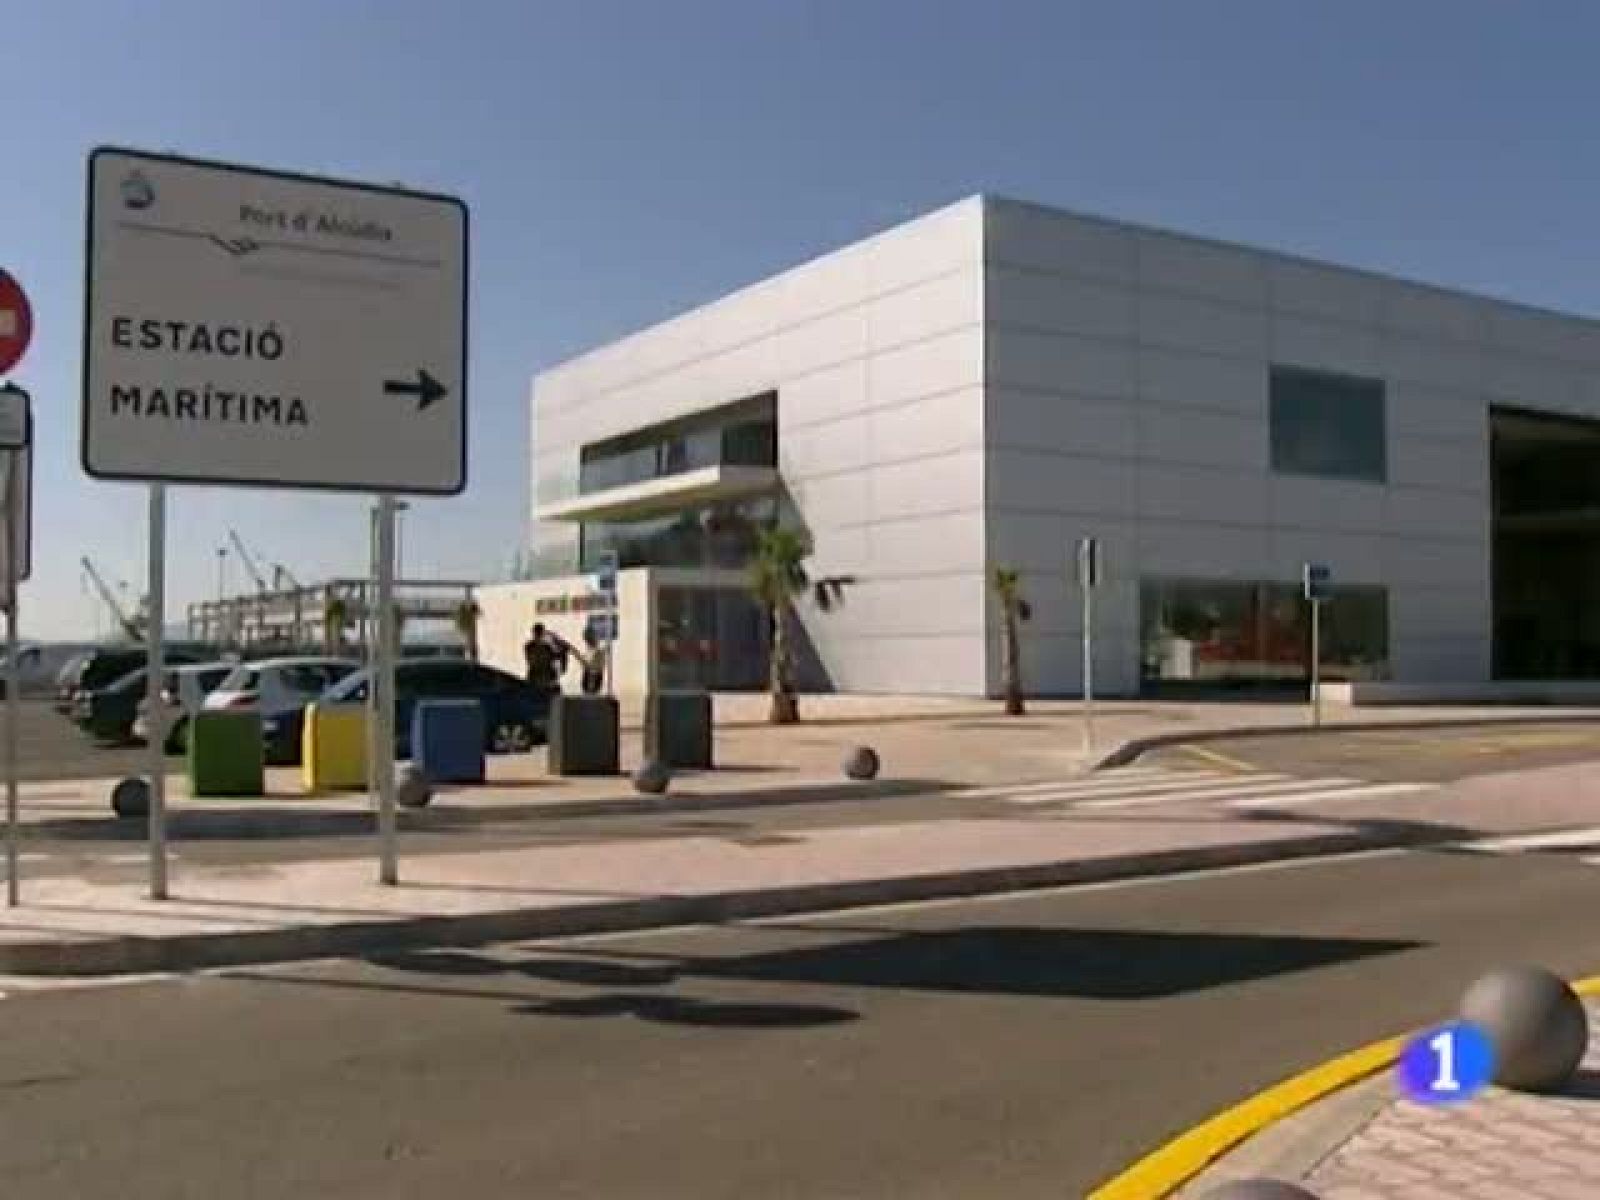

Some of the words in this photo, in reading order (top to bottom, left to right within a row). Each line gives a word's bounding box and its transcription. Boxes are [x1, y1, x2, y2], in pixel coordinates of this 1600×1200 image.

[239, 204, 289, 230] Port
[111, 317, 284, 361] ESTACIÓ
[110, 383, 308, 426] MARÍTIMA
